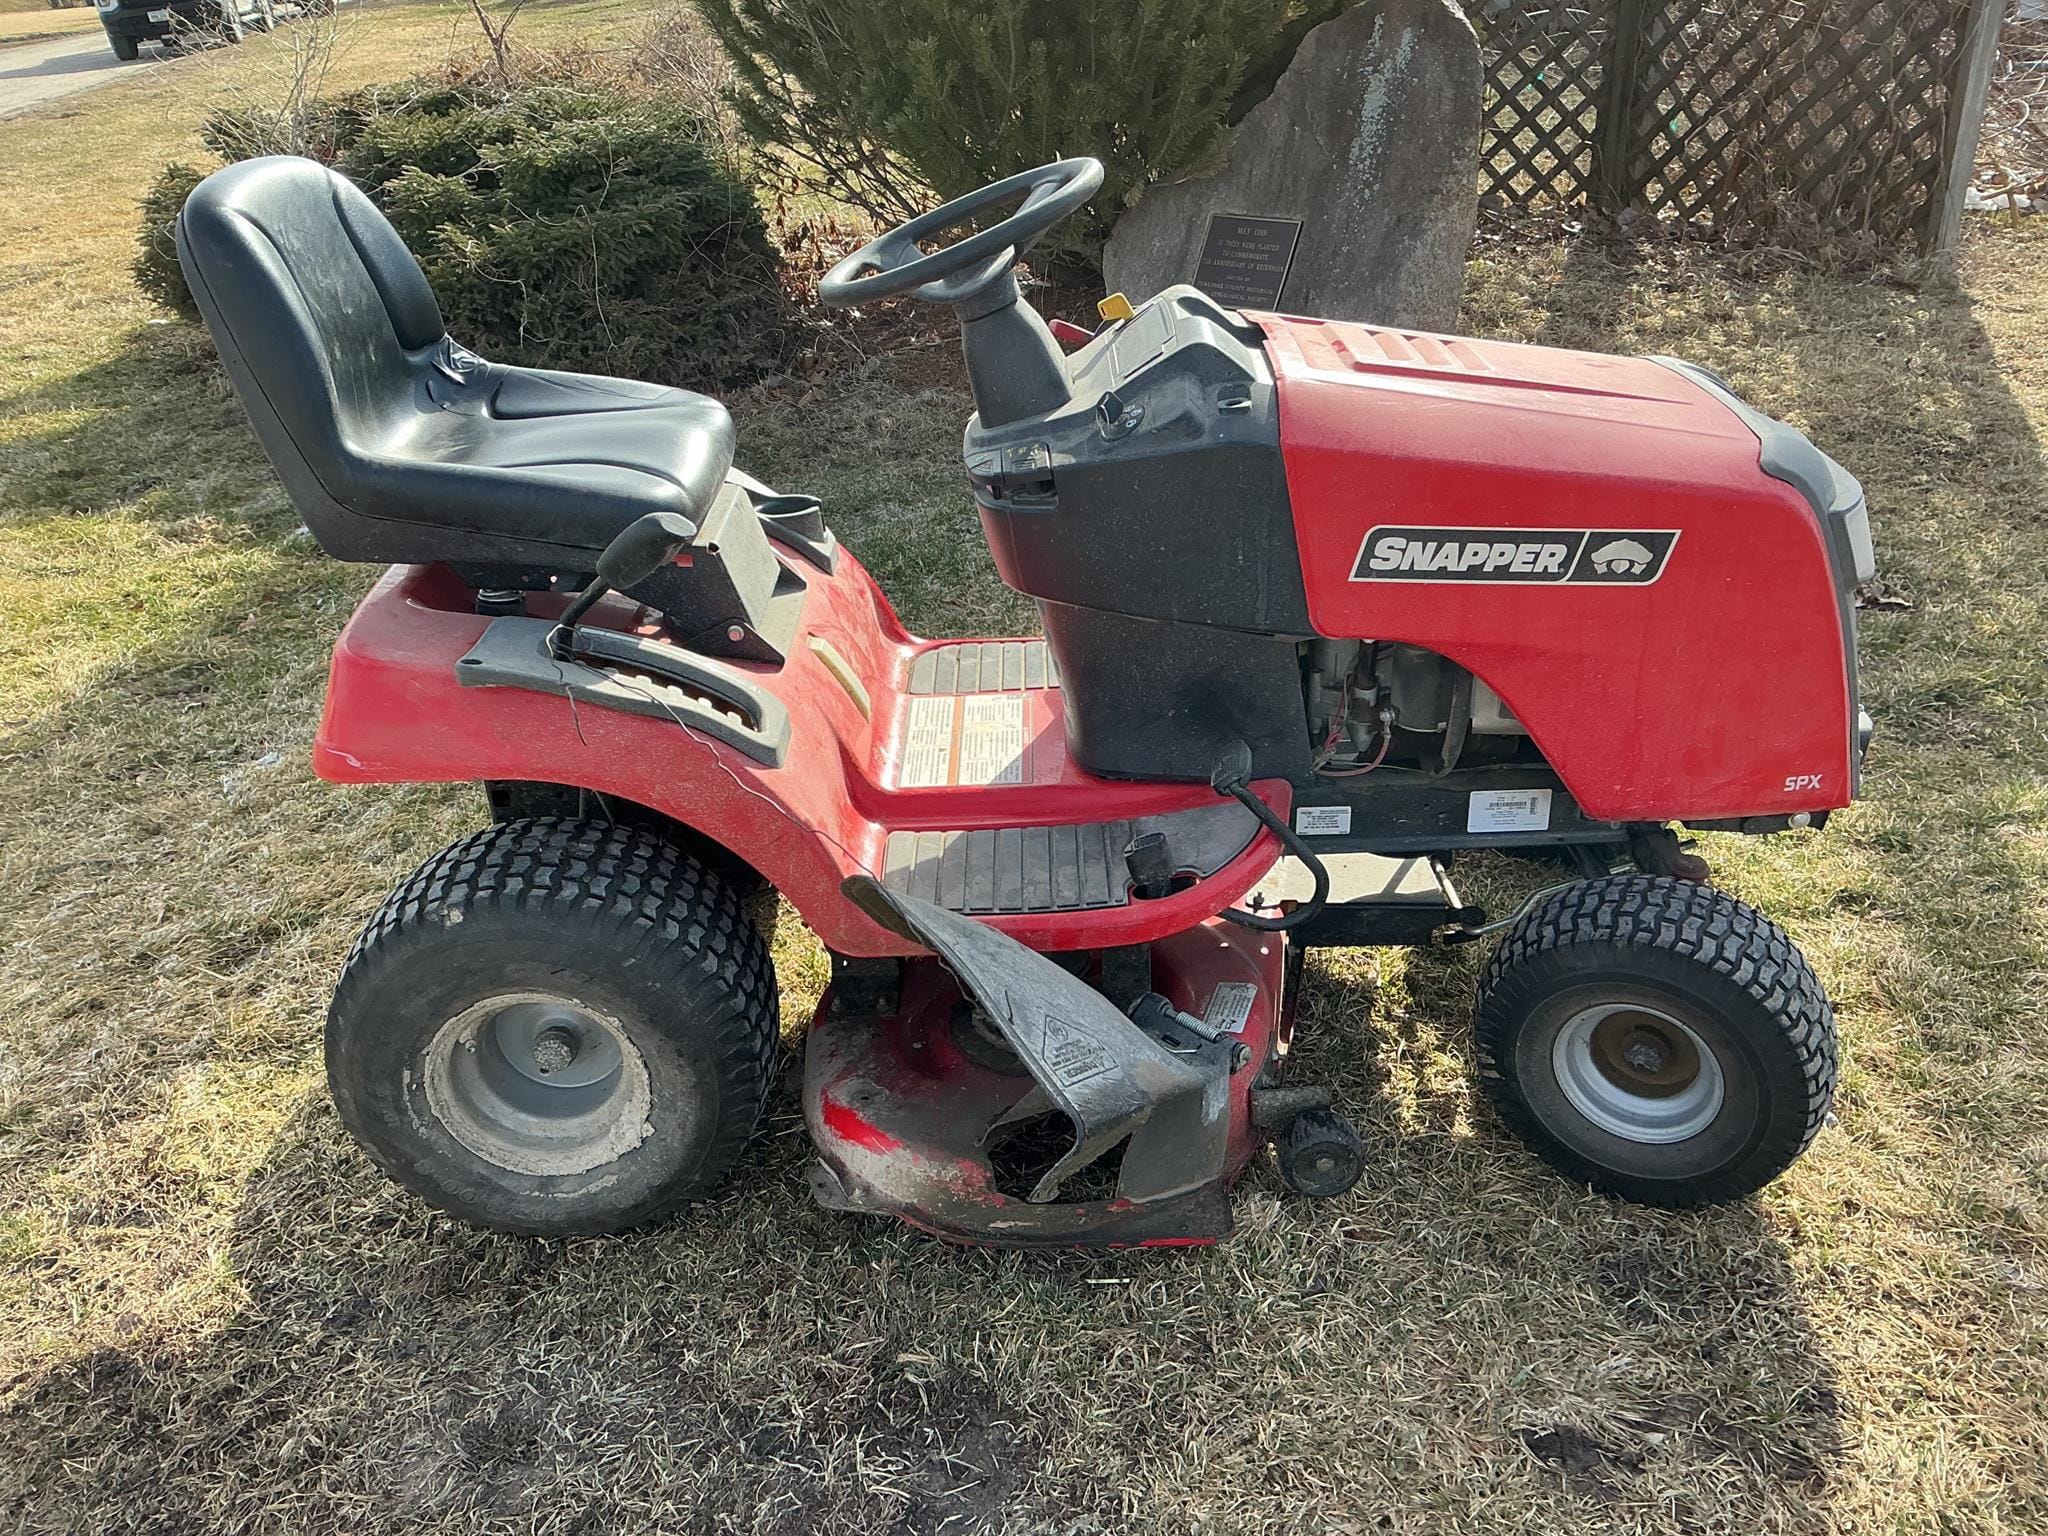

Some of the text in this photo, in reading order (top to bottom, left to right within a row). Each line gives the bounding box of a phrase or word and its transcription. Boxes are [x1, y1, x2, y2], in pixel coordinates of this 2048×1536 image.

[1237, 227, 1250, 236] MAY
[1242, 241, 1255, 250] WERE
[1257, 243, 1280, 252] PLANTED
[1231, 250, 1269, 261] COMMEMORATE
[1214, 259, 1245, 269] ANNIVERSARY
[1247, 262, 1255, 270] OF
[1225, 284, 1245, 293] COUNTY
[1368, 536, 1568, 573] SNAPPER
[1783, 774, 1823, 791] SPX
